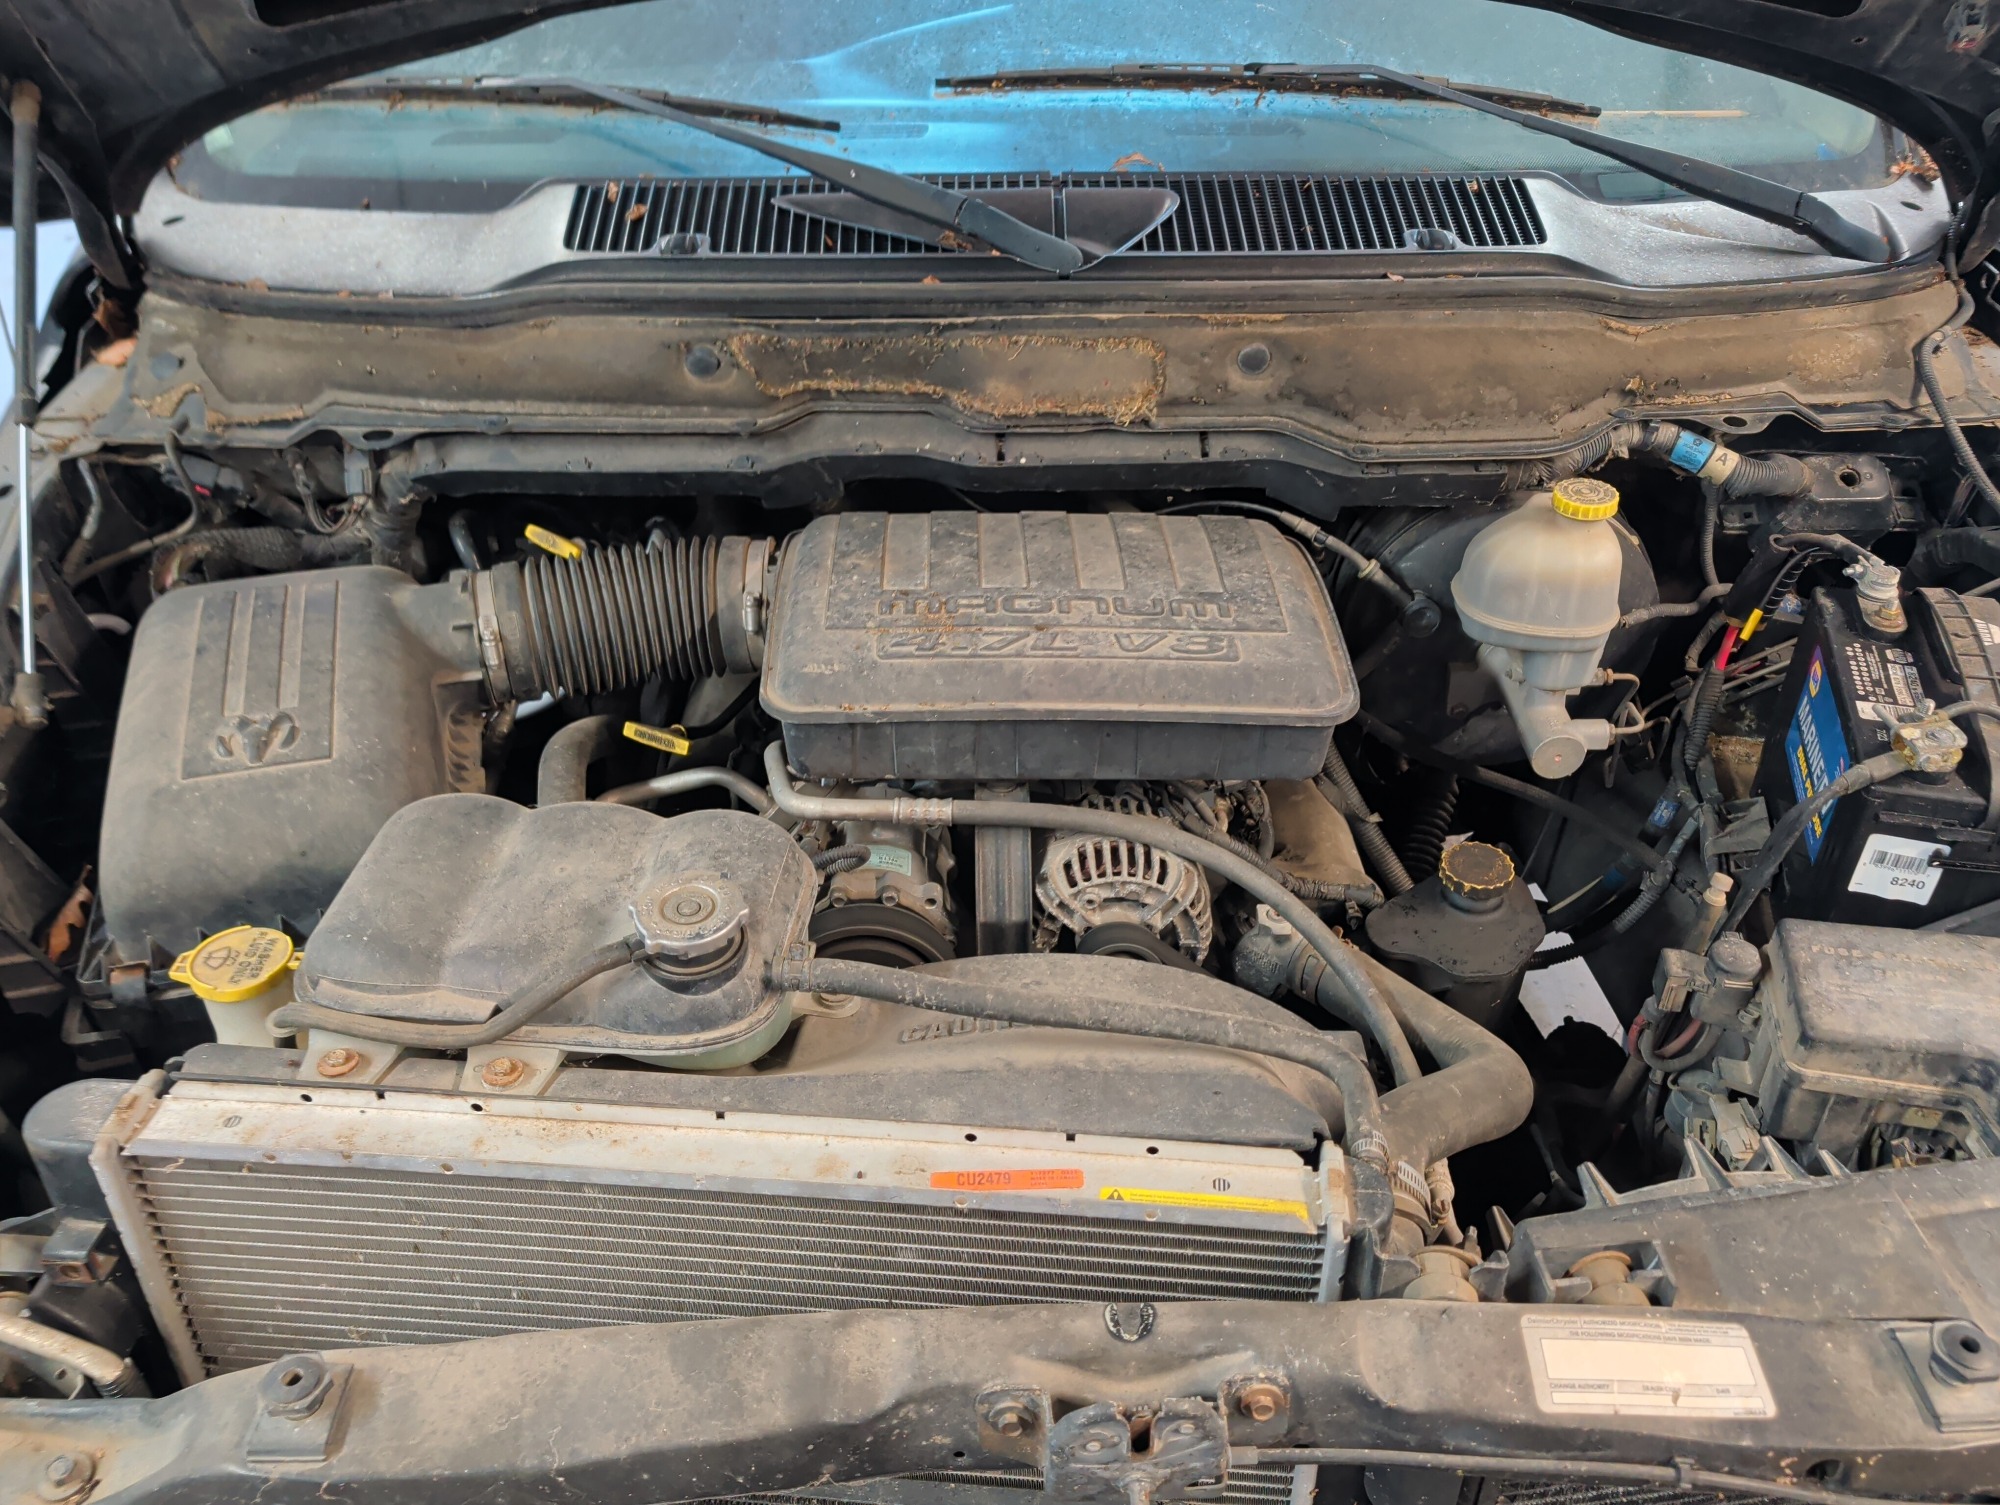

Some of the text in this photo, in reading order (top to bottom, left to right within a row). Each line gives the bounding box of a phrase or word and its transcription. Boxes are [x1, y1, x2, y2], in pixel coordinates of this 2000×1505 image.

[1715, 452, 1728, 466] A
[890, 632, 1227, 656] 4.7L V8
[1796, 743, 1811, 782] DUAL
[1804, 780, 1823, 840] PUSE
[1889, 876, 1926, 890] 8240
[956, 1171, 1012, 1187] CU2479
